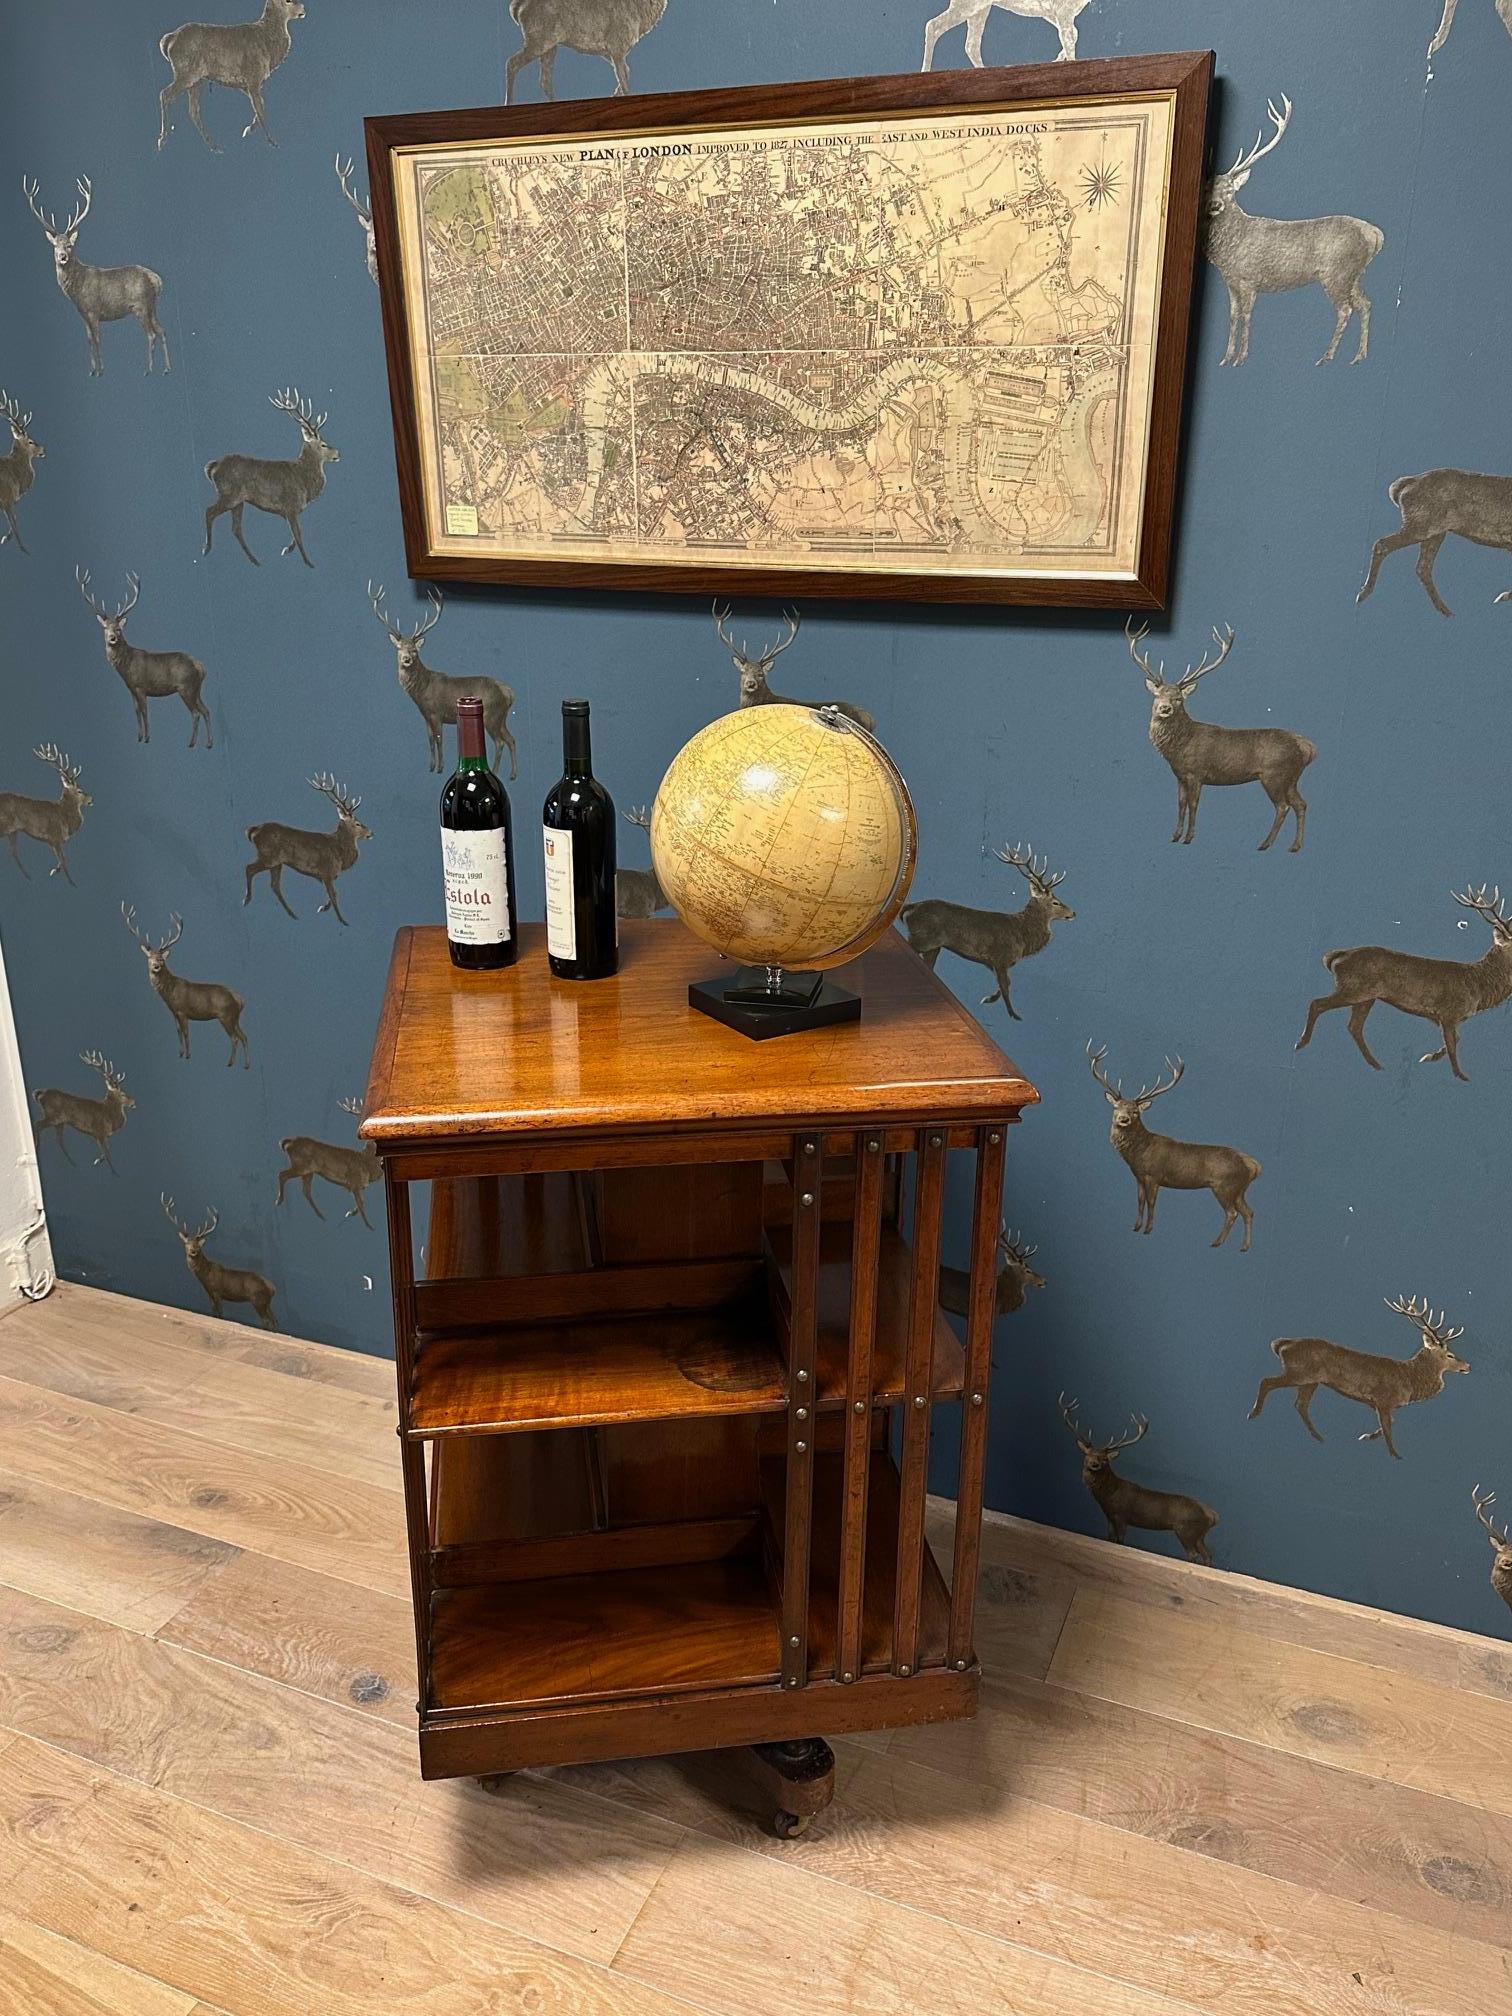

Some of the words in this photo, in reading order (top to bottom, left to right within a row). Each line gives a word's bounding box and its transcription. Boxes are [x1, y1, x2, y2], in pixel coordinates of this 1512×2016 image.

[552, 153, 574, 164] NEW
[578, 148, 614, 161] PLAN
[632, 144, 690, 158] LONDON
[696, 142, 749, 154] IMPROVED
[752, 141, 767, 151] TO
[792, 134, 851, 149] INCLUDING
[856, 135, 873, 146] THE
[909, 132, 928, 142] AND
[931, 128, 964, 139] WEST
[967, 126, 1001, 138] INDIA
[1006, 122, 1048, 135] DOCKS
